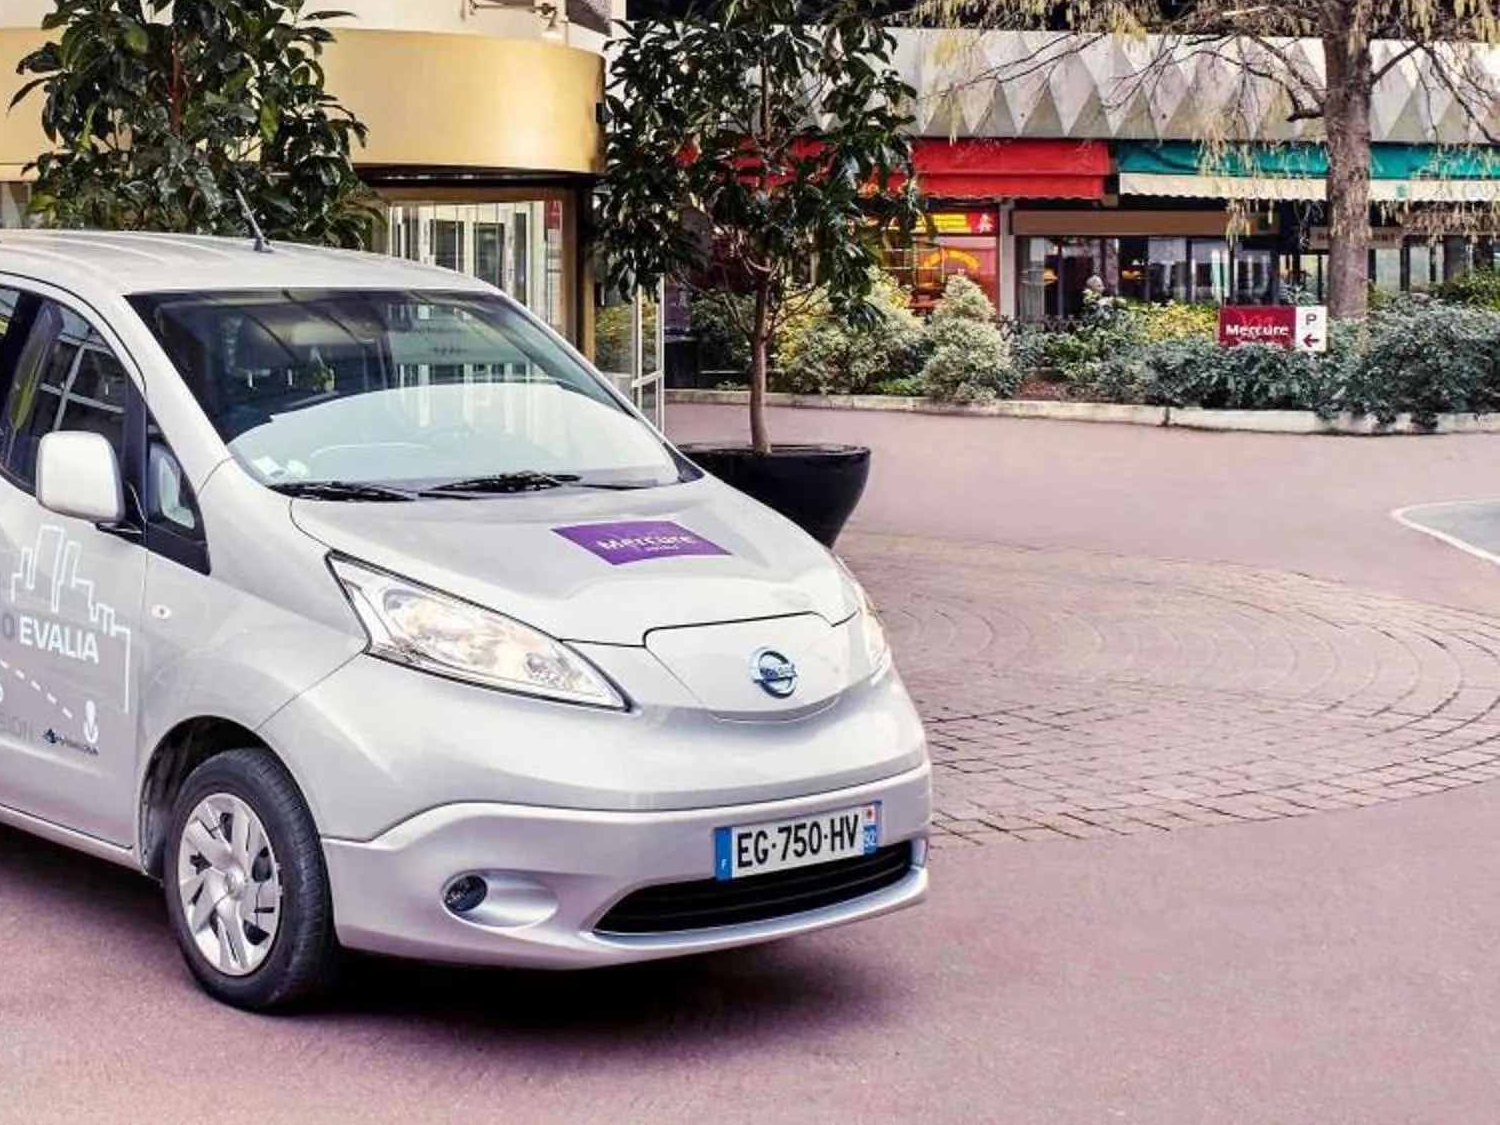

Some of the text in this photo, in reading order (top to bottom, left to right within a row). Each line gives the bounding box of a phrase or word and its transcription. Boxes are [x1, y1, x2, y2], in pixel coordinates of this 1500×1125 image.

[1305, 313, 1317, 325] P
[1225, 324, 1289, 337] Mercure
[19, 615, 99, 664] EVALIA
